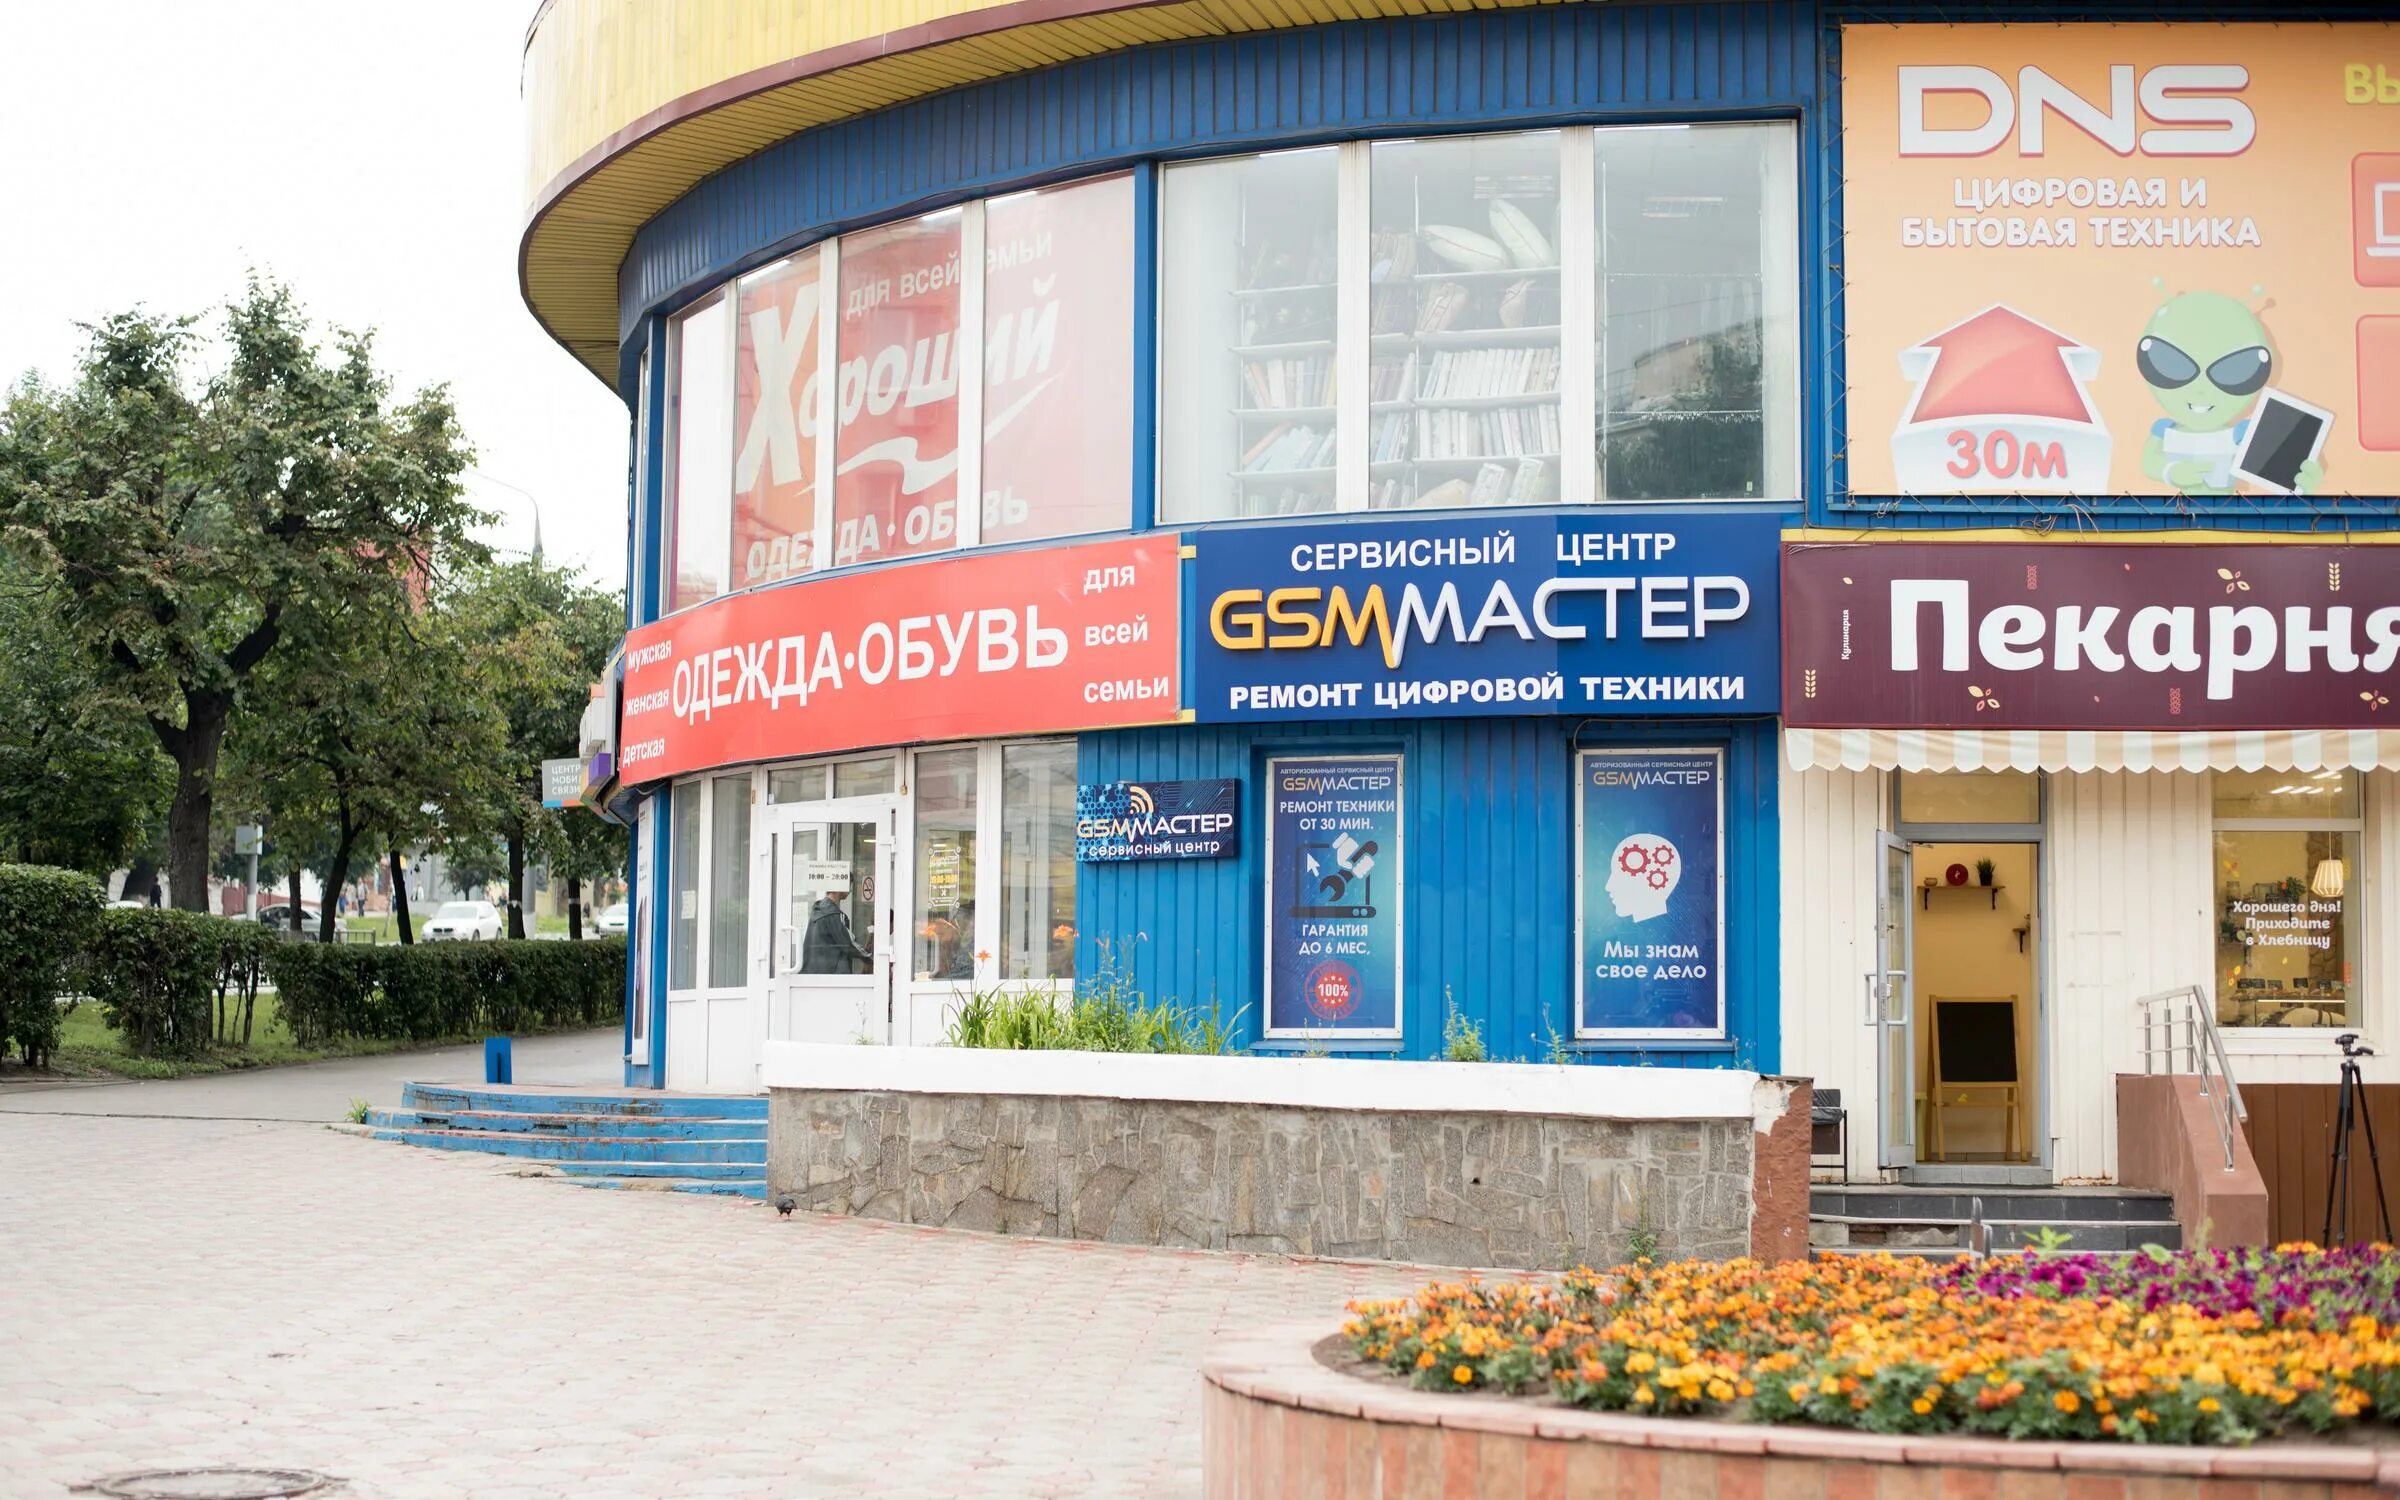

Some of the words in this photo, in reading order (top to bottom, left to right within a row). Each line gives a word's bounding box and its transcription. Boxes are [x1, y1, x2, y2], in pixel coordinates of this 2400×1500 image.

[1898, 64, 2256, 158] DNS
[1954, 177, 2167, 213] ЦИФРОВАЯ
[2179, 178, 2208, 208] И
[1901, 216, 2077, 248] БЫТОВАЯ
[2088, 216, 2262, 248] ТЕХНИКА
[1291, 530, 1516, 571] СЕРВИСНЫЙ
[1556, 532, 1677, 566] ЦЕНТР
[1083, 565, 1136, 594] для
[1084, 613, 1149, 646] всей
[1890, 579, 2400, 700] Пекарня
[628, 639, 672, 672] мужская
[625, 688, 669, 717] женская
[1083, 676, 1169, 704] семьи
[1230, 680, 1362, 710] РЕМОНТ
[1374, 671, 1564, 709] ЦИФРОВОЙ
[1579, 676, 1745, 701] ТЕХНИКИ
[622, 737, 665, 768] детская
[1280, 801, 1333, 813] РЕМОНТ
[1336, 800, 1395, 813] ТЕХНИКИ
[1299, 818, 1318, 830] ОТ
[1320, 818, 1336, 830] 30
[1339, 818, 1374, 830] МИН.
[2233, 901, 2306, 915] Хорошего
[2310, 900, 2341, 913] дня!
[1302, 924, 1368, 937] ГАРАНТИЯ
[2245, 917, 2331, 931] Приходите
[1299, 941, 1322, 955] ДО
[1325, 941, 1333, 954] 6
[1603, 941, 1639, 958] Мы
[2246, 935, 2254, 945] в
[2258, 934, 2331, 949] Хлебницу
[1596, 965, 1648, 979] свое
[1653, 964, 1707, 980] дело
[1318, 983, 1349, 997] 100%
